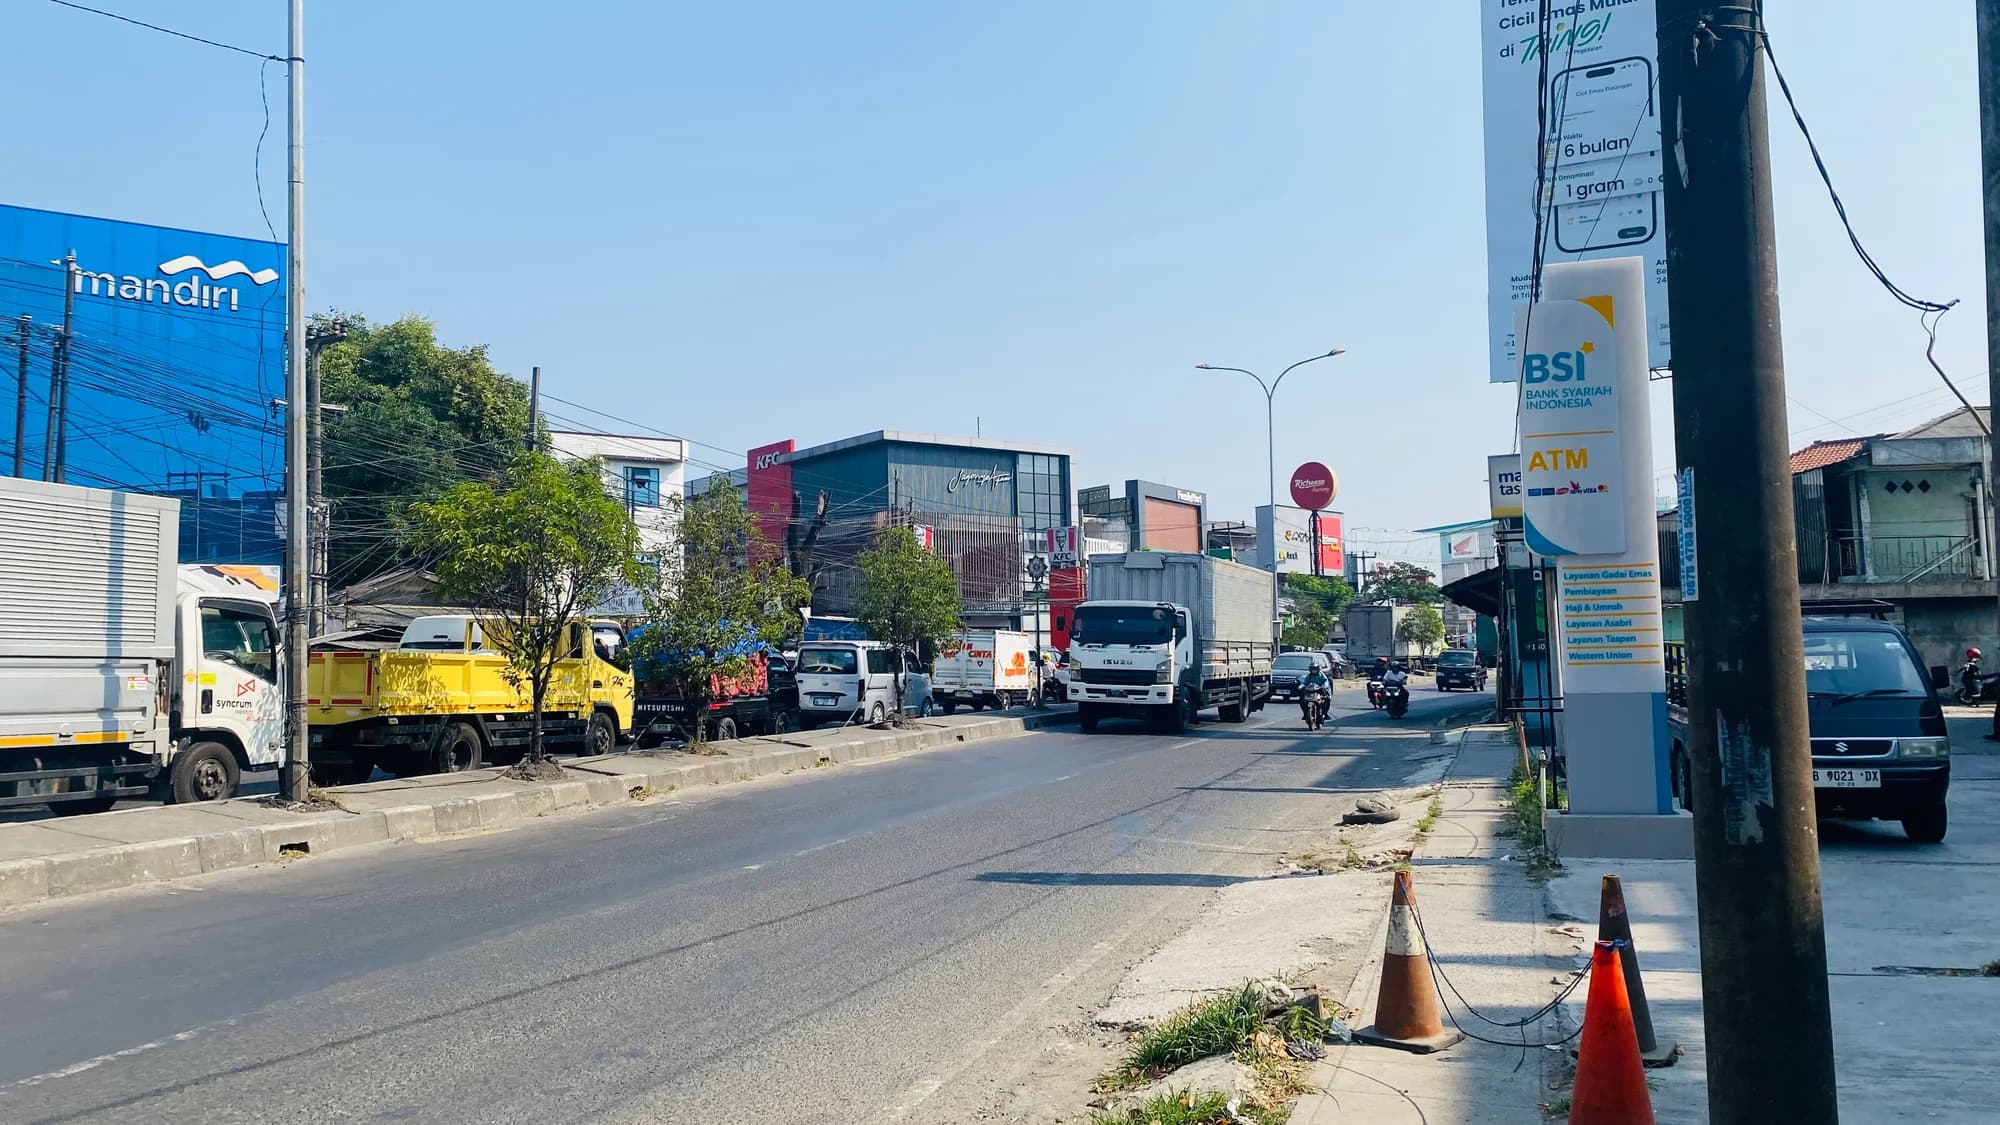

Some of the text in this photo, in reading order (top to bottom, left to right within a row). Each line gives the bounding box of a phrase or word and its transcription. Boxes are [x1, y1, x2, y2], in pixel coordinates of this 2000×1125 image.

[1499, 11, 1535, 29] Cicil
[1544, 4, 1586, 21] mas
[1500, 44, 1514, 57] di
[1565, 138, 1629, 157] 6 bulan
[1566, 184, 1571, 198] 1
[1577, 179, 1624, 200] gram
[74, 267, 238, 311] mandiri
[1525, 350, 1585, 384] BSI
[1526, 386, 1612, 399] BANK SYARIAH
[1526, 398, 1593, 410] INDONESIA
[757, 451, 780, 470] KFC
[1528, 448, 1588, 472] ATM
[1053, 552, 1072, 561] KFC
[1564, 569, 1652, 581] Layanan Gadai Emas
[1565, 587, 1617, 596] Pembiayaan
[1565, 604, 1582, 613] Haji
[1584, 603, 1591, 611] &
[1566, 619, 1632, 629] Layanan Asabri
[1567, 635, 1636, 645] Layanan Taspen
[1568, 651, 1632, 660] Western Union
[216, 699, 252, 709] syncrum
[1827, 771, 1854, 781] 9021
[1865, 771, 1879, 781] DX
